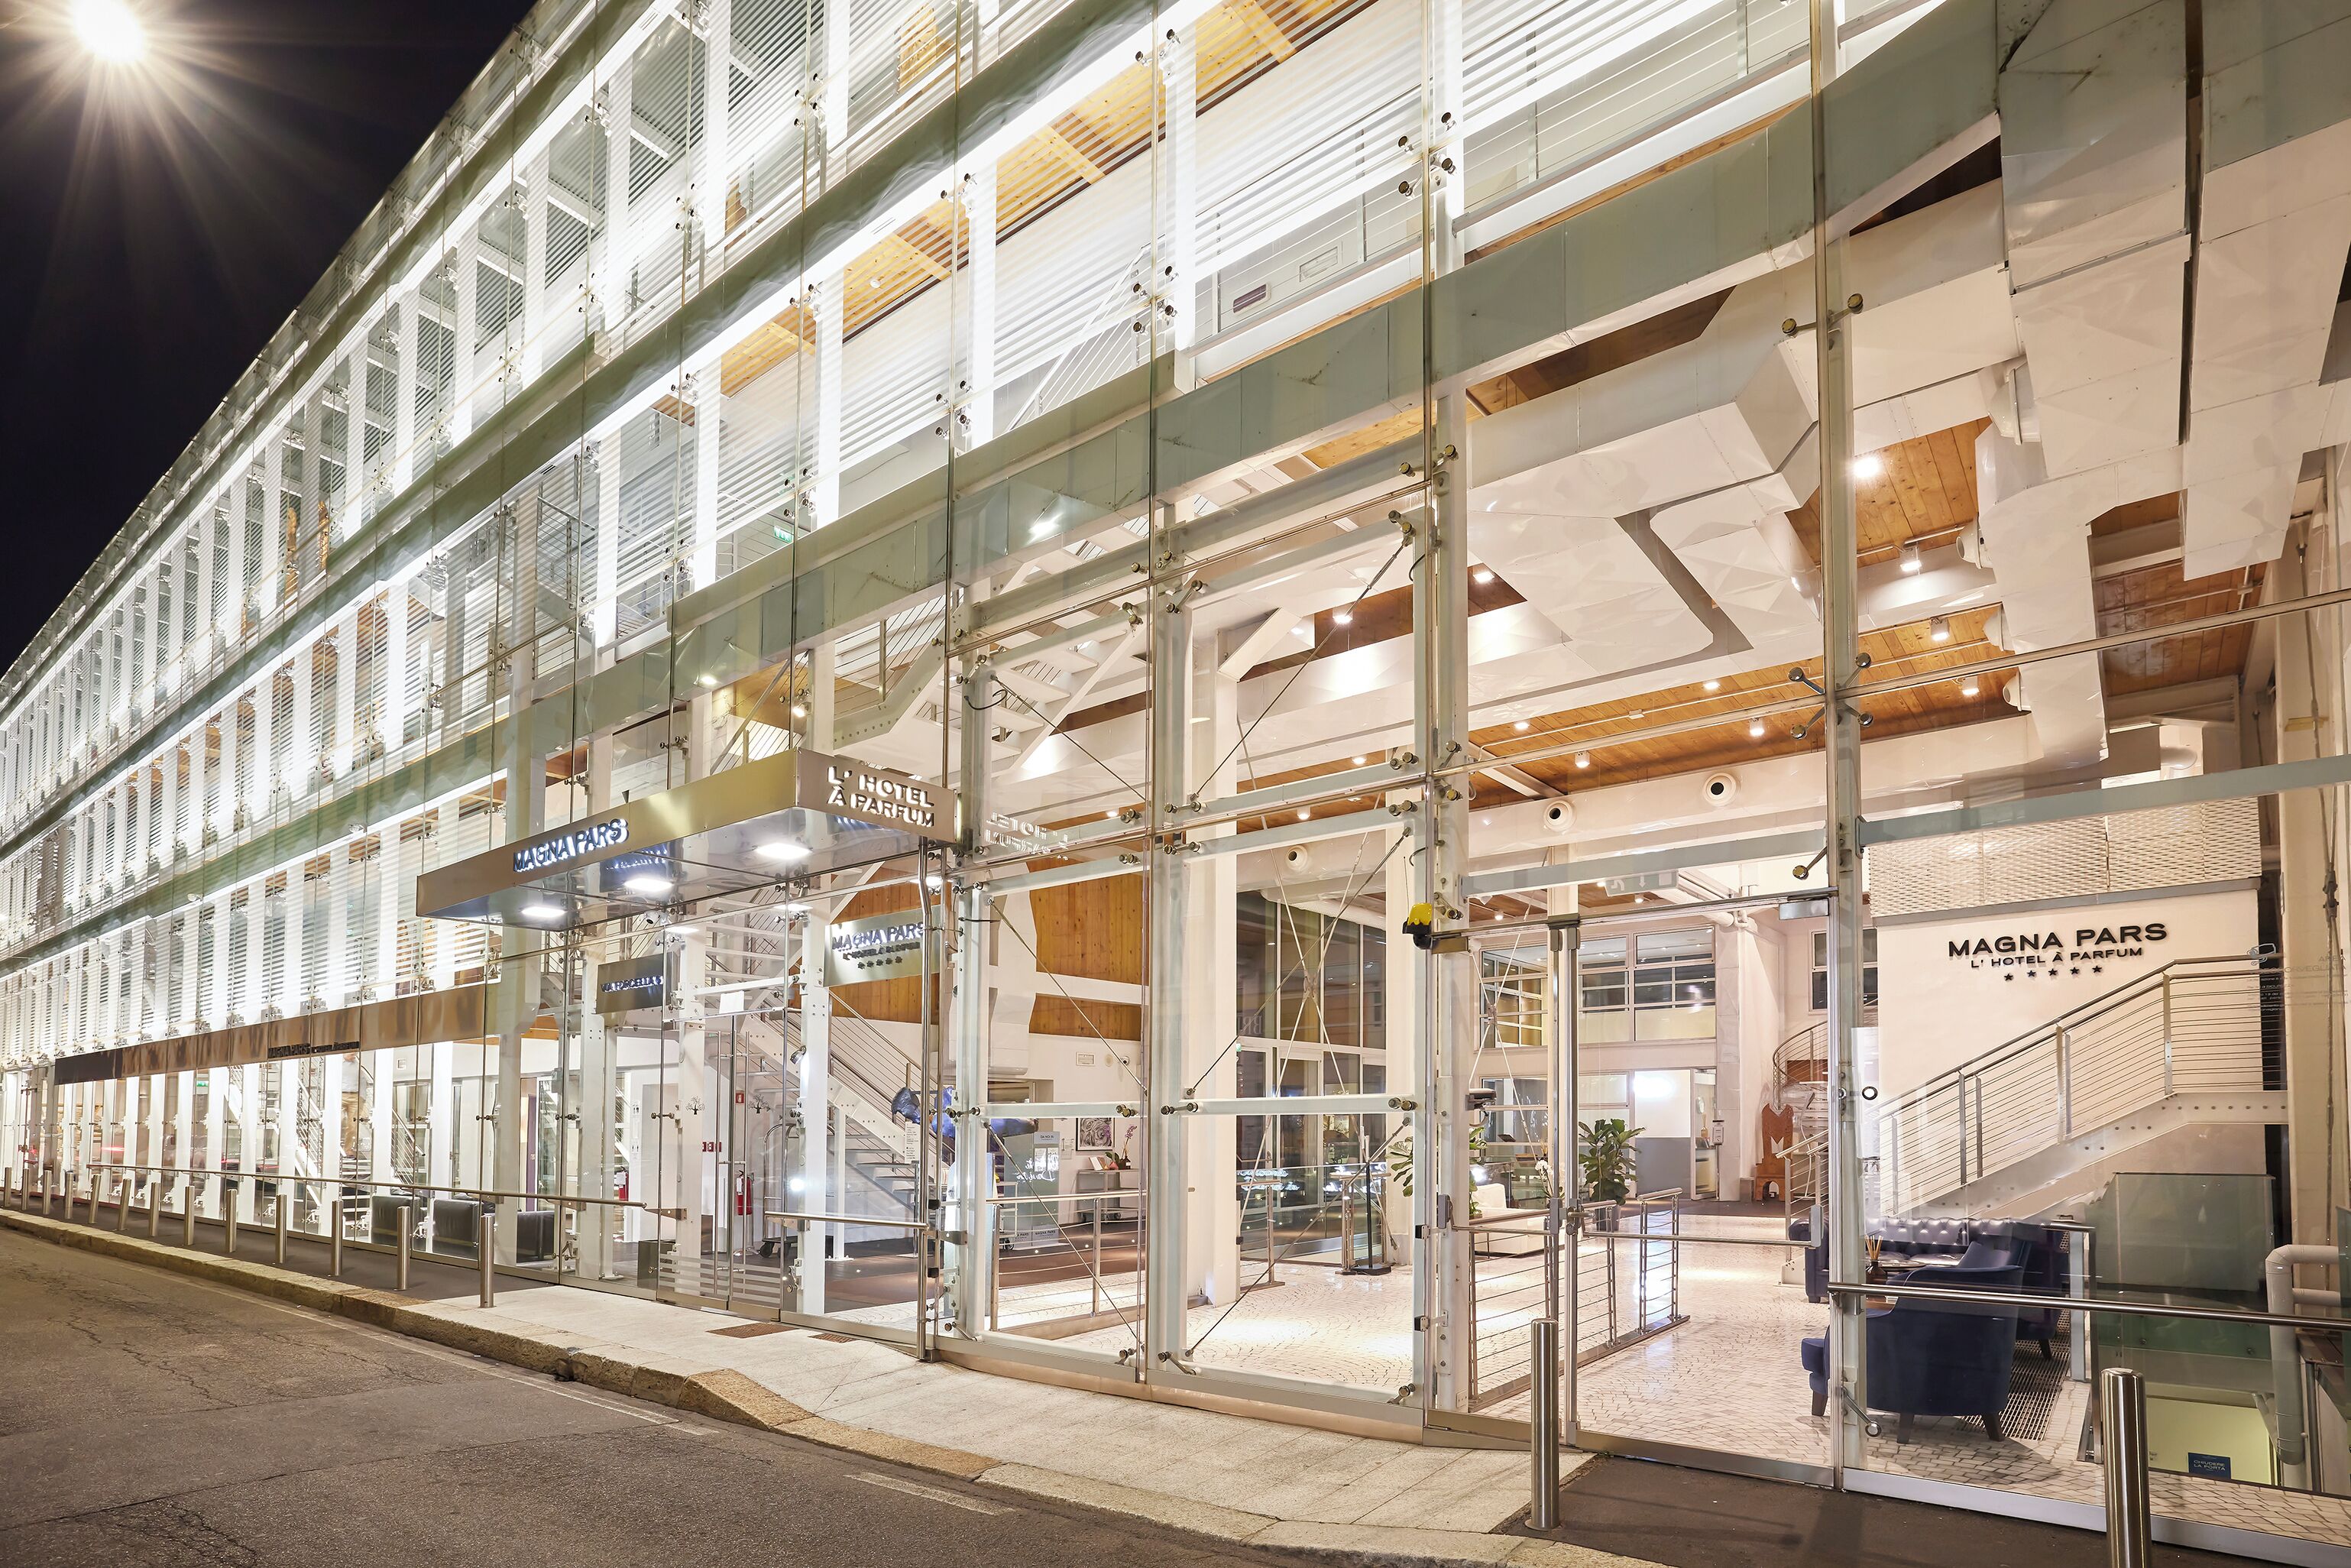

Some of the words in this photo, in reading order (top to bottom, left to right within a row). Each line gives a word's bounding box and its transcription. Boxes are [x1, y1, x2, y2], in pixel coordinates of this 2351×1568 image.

[827, 785, 847, 807] À
[850, 793, 934, 828] PARFUM
[858, 774, 934, 808] HOTEL
[513, 835, 576, 873] MAGNA
[575, 818, 630, 854] PARS
[831, 928, 883, 951] MAGNA
[886, 921, 925, 944] PARS
[1948, 931, 2064, 957] MAGNA
[2076, 923, 2168, 947] PARS
[1971, 959, 1983, 968] L'
[1991, 955, 2046, 967] HOTEL
[2052, 951, 2064, 962] À
[2070, 948, 2142, 961] PARFUM
